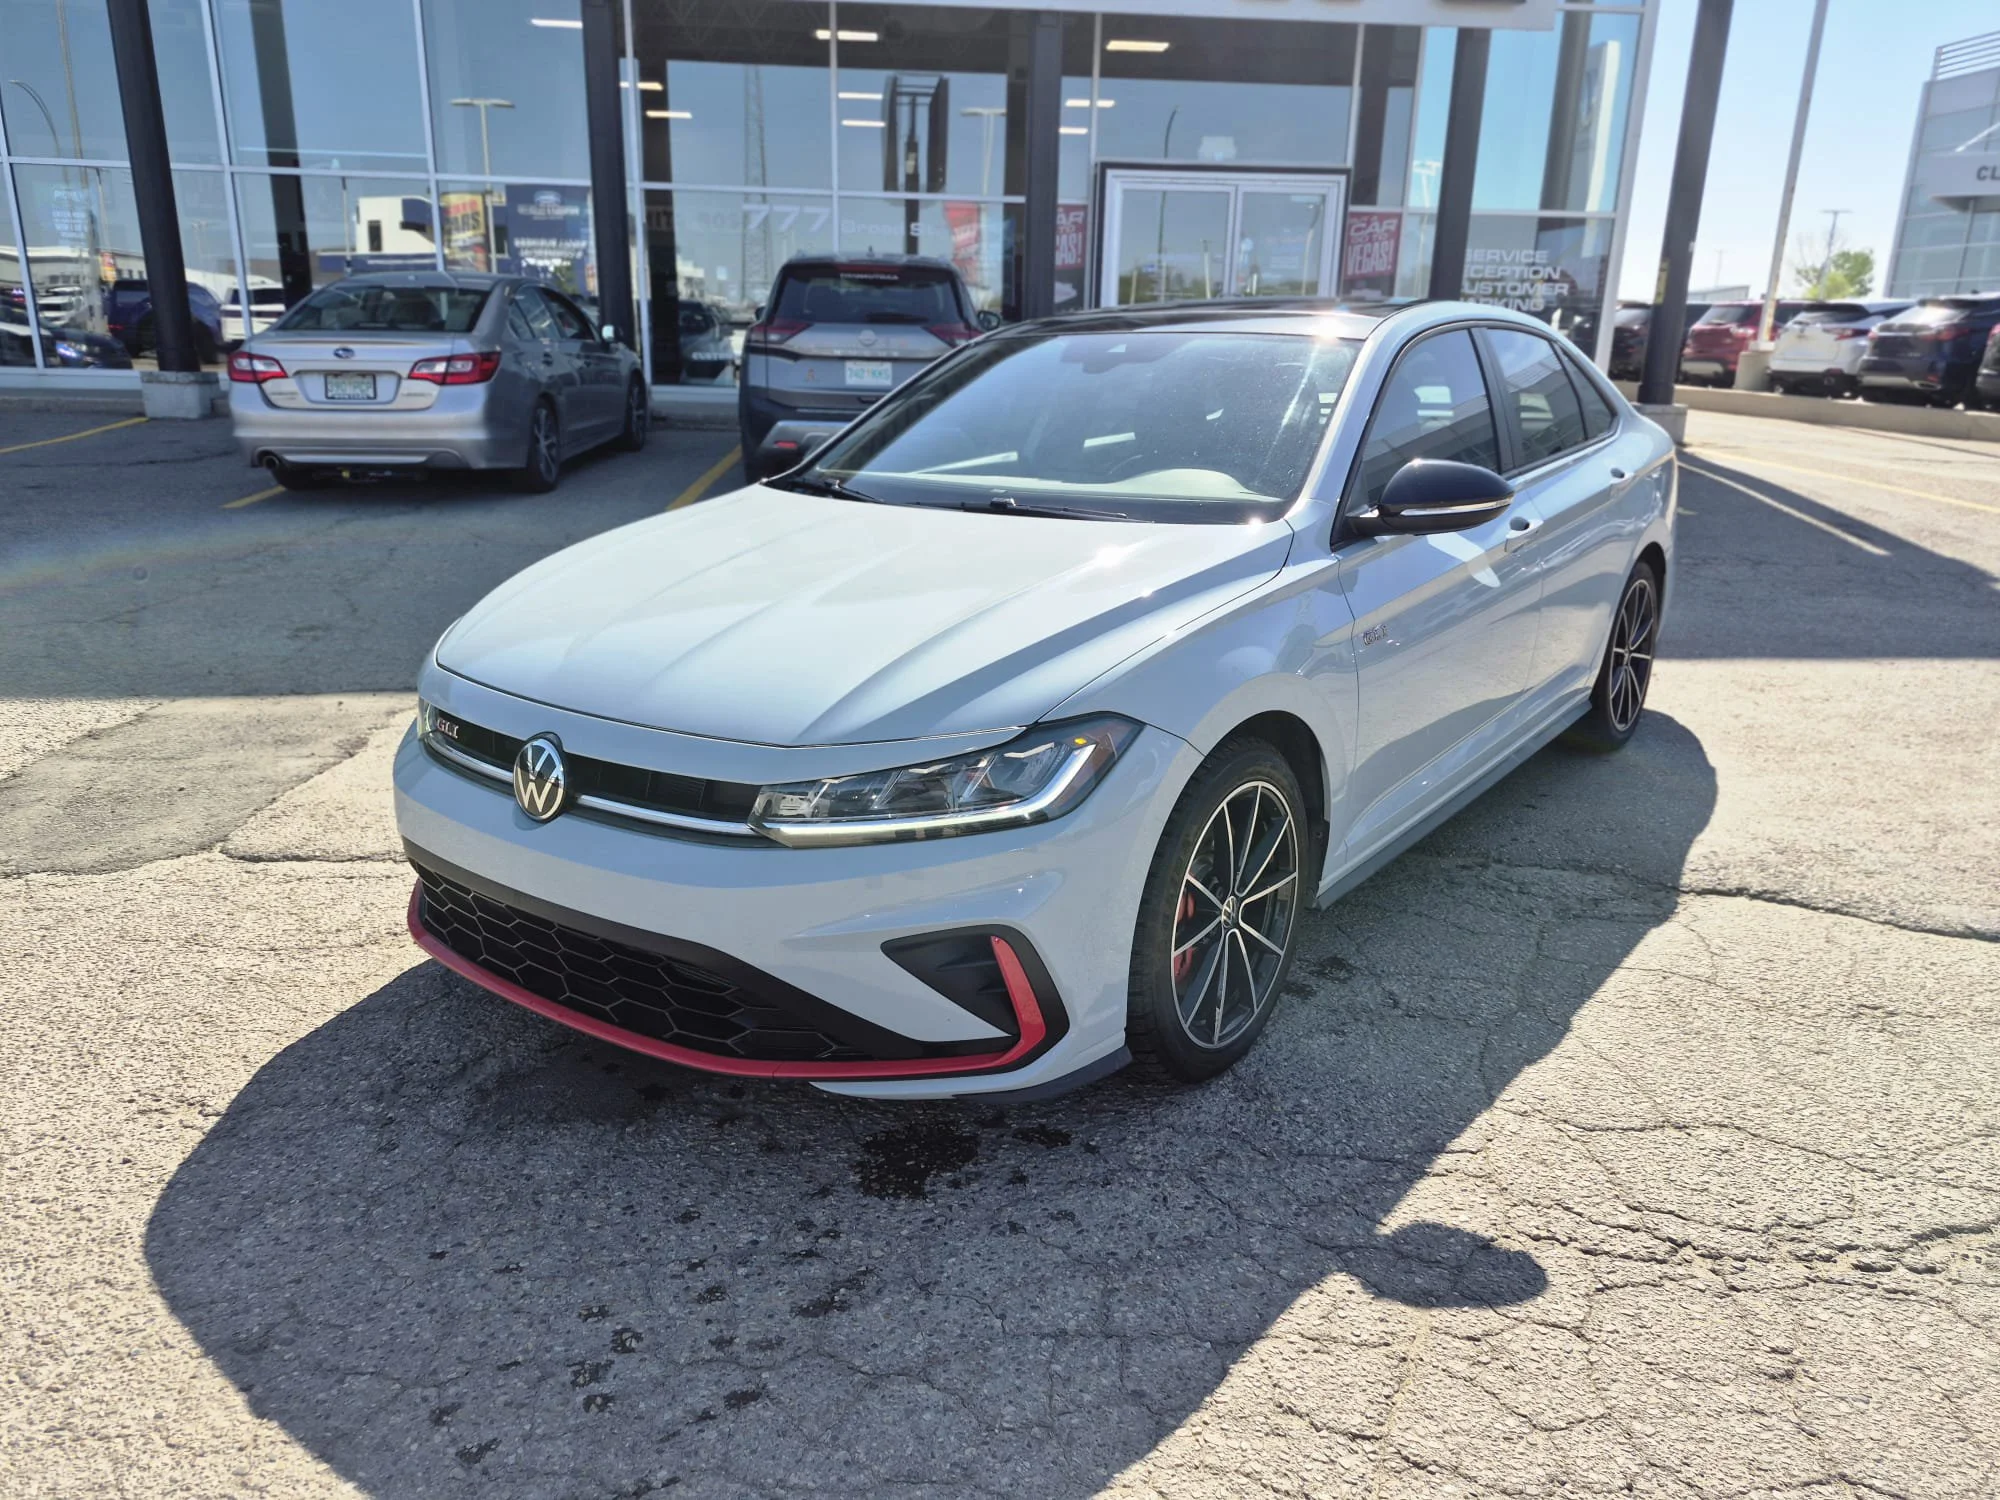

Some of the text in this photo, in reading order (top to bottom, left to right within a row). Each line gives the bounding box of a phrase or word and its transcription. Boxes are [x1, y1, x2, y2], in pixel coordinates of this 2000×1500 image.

[741, 203, 832, 232] 777
[1056, 211, 1084, 225] AR
[1347, 239, 1394, 276] VEGAS!
[1464, 264, 1562, 279] CEPTION
[1461, 281, 1569, 296] USTOMER
[1460, 296, 1546, 311] RKING
[437, 718, 459, 739] GLI
[514, 738, 564, 820] VW
